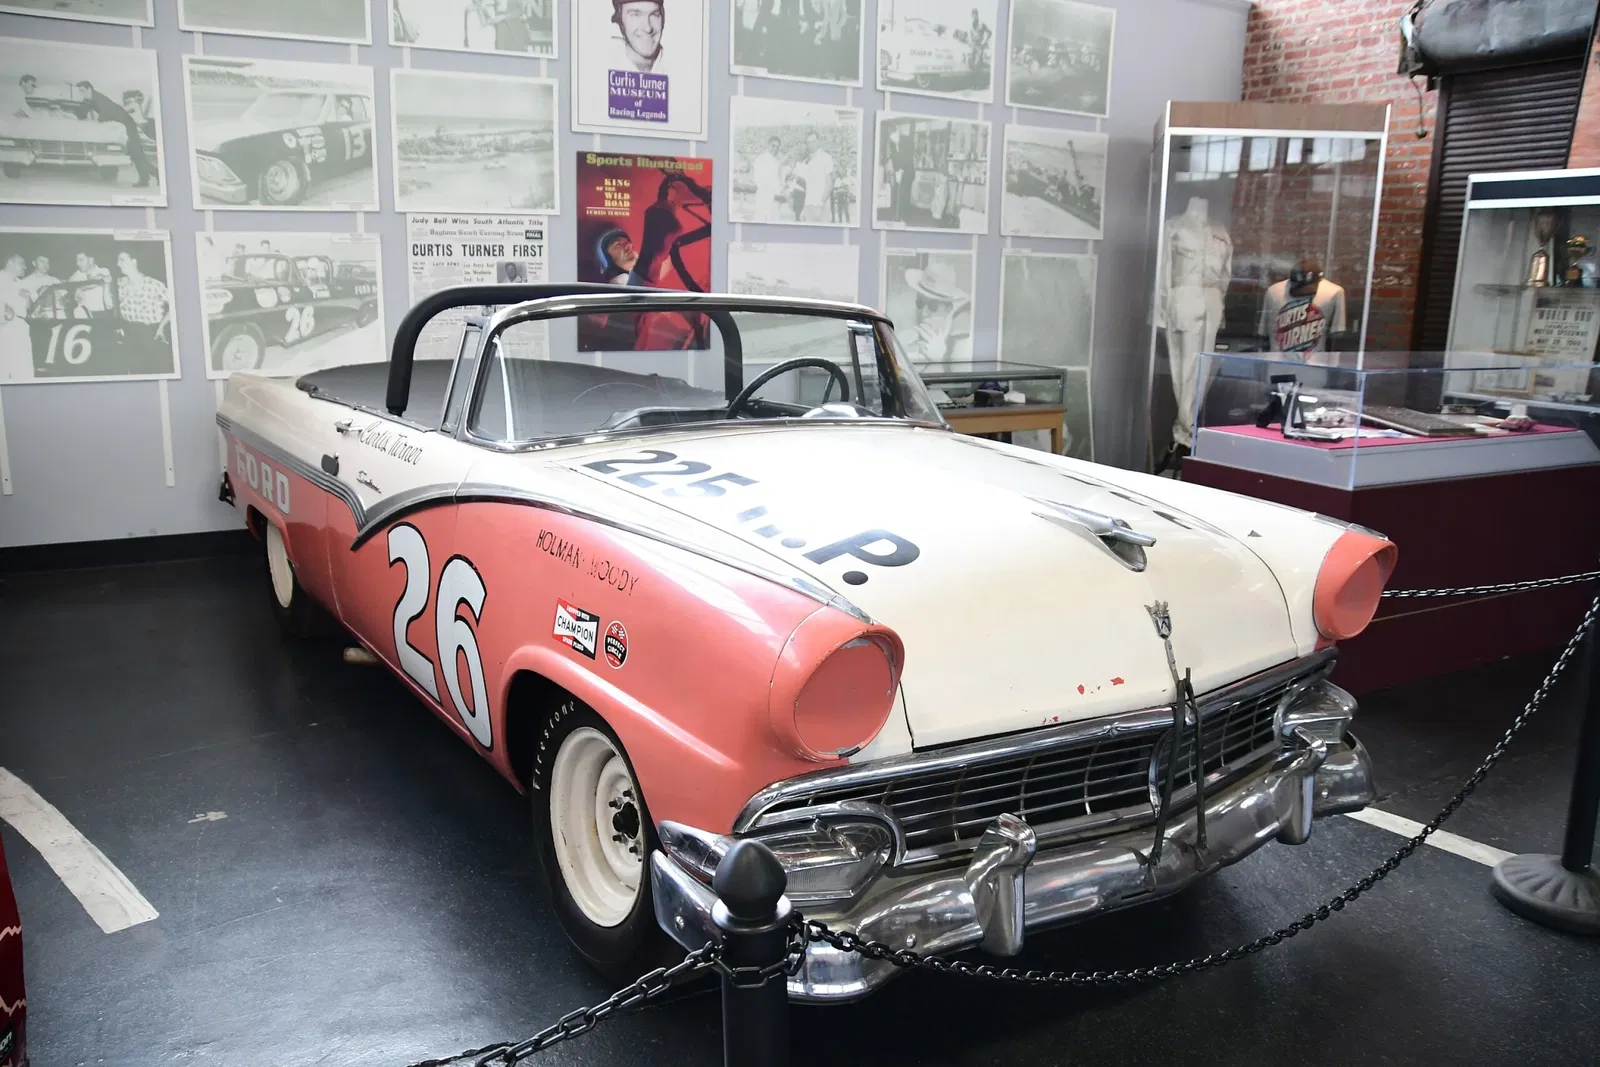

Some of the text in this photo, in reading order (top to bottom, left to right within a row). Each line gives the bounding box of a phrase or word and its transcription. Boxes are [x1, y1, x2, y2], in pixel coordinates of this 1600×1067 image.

[609, 70, 667, 90] Curtis Turner
[609, 86, 667, 100] MUSEUM
[634, 99, 643, 107] of
[609, 107, 667, 120] Racing Legends
[341, 123, 366, 161] 13
[586, 153, 704, 172] Sports Illustrated
[604, 178, 631, 187] KING
[604, 192, 630, 200] WILD
[604, 199, 630, 208] ROAD
[412, 216, 429, 225] Judy
[451, 217, 469, 225] Wins
[497, 218, 525, 226] Atlantic
[429, 228, 457, 237] Daytona
[412, 243, 544, 258] CURTIS TURNER FIRST
[284, 306, 316, 344] 26
[45, 324, 92, 365] 16
[360, 420, 423, 466] Curtis Turner
[234, 442, 290, 515] FORD
[581, 450, 760, 498] 225
[536, 529, 582, 569] HOLMAN
[386, 521, 494, 752] 26
[557, 615, 595, 643] CHAMPION
[607, 636, 626, 654] PERFECT
[607, 645, 622, 660] CIRCLE
